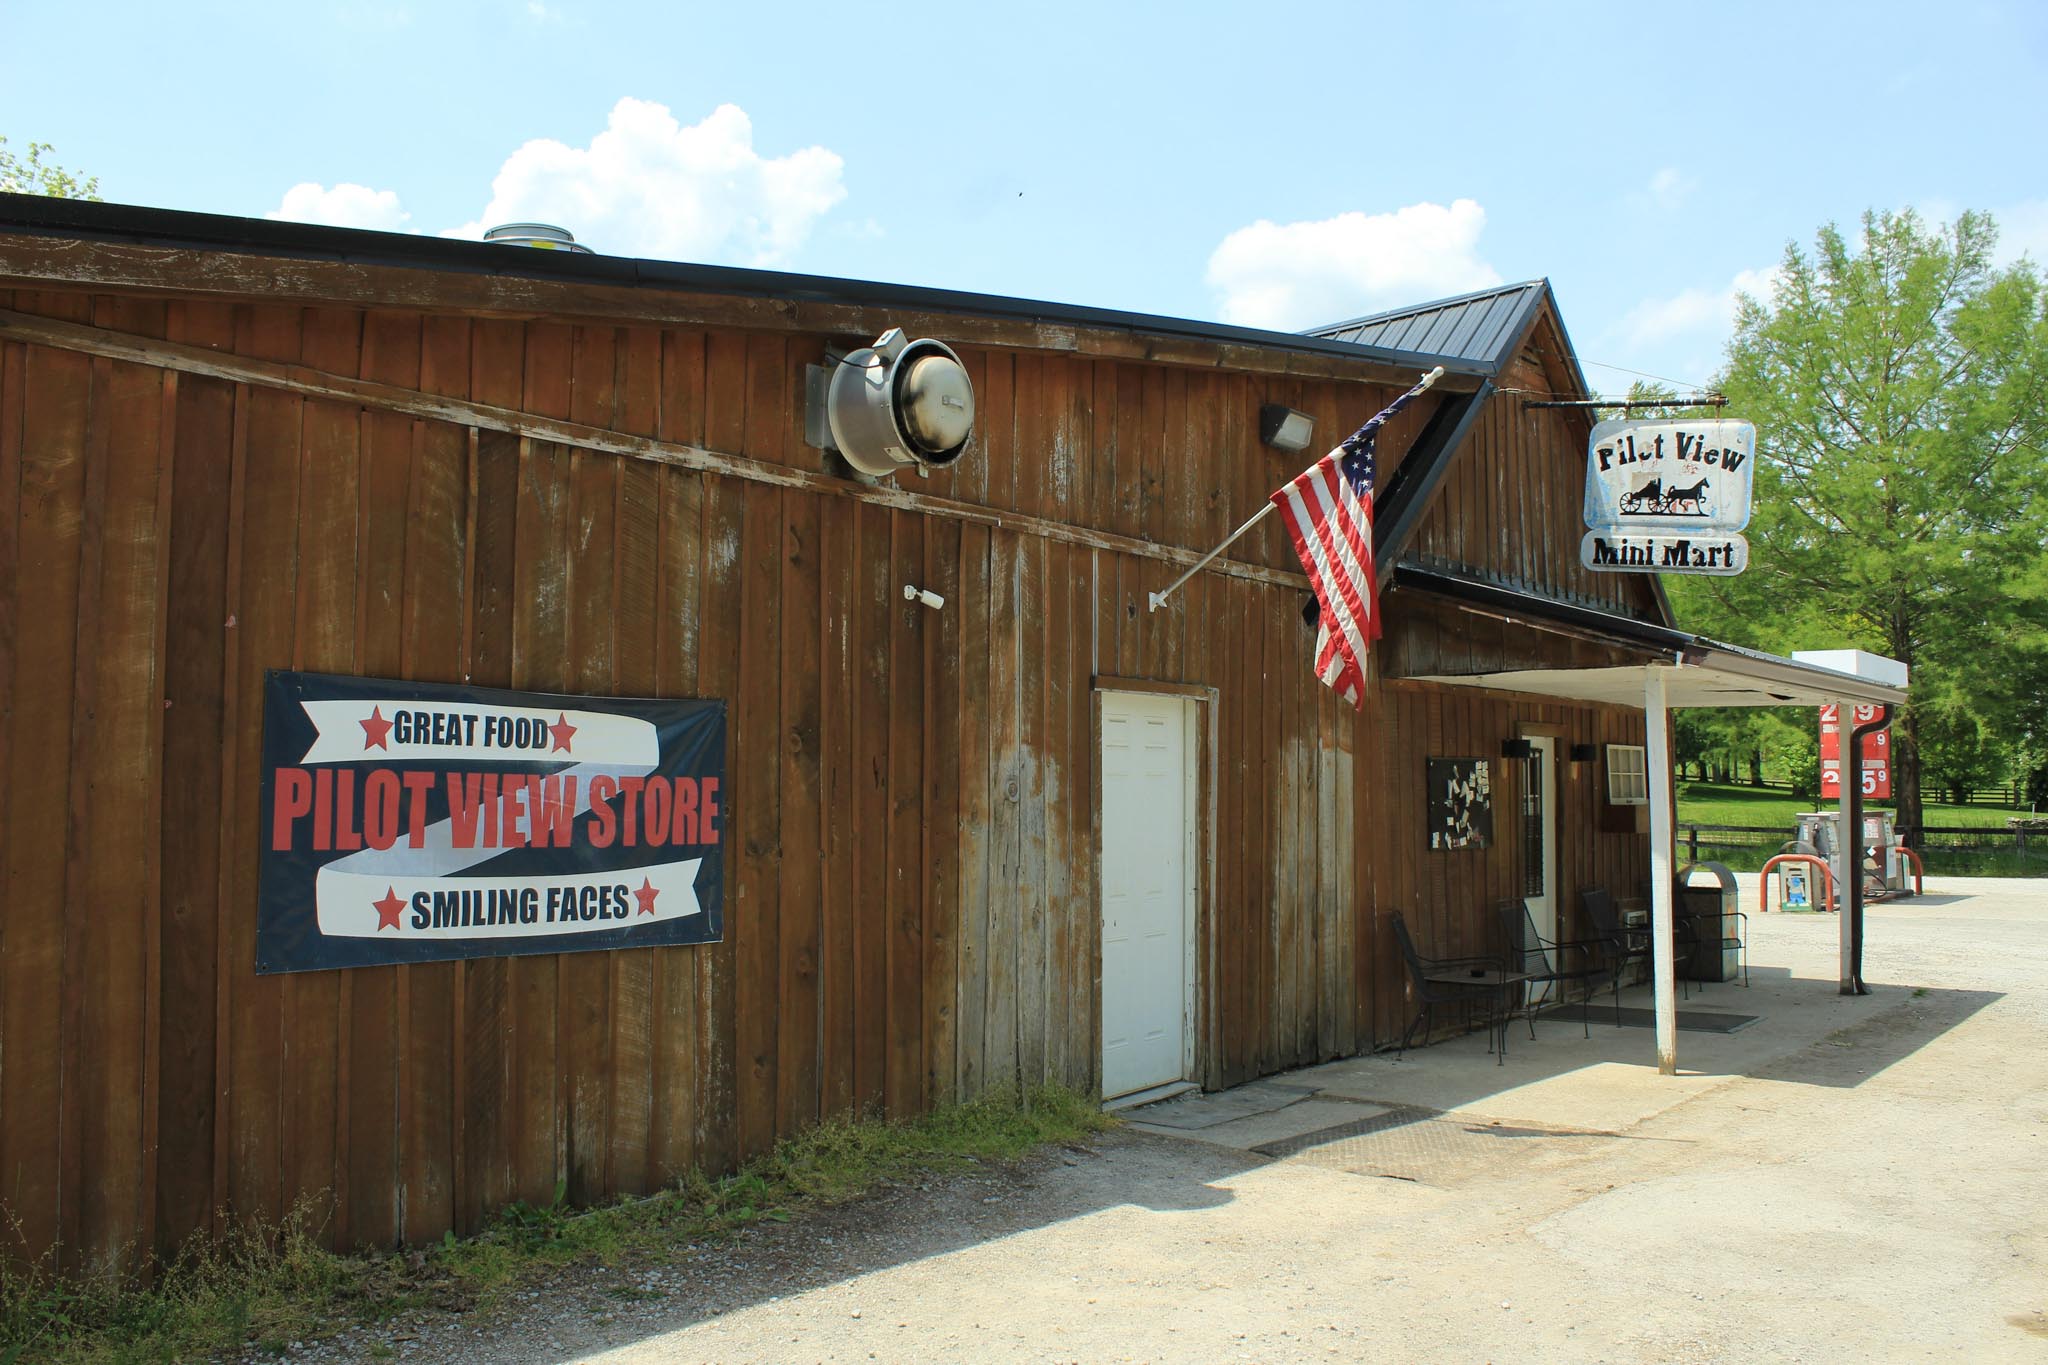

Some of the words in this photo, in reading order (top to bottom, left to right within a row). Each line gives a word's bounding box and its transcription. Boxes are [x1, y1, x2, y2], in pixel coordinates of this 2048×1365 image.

[1676, 432, 1746, 473] View
[1592, 538, 1653, 564] Mini
[1662, 540, 1734, 567] Mart
[394, 710, 478, 746] GREAT
[484, 715, 549, 749] FOOD
[272, 767, 435, 851] PILOT
[447, 772, 577, 849] VIEW
[588, 775, 719, 848] STORE
[411, 886, 538, 930] SMILING
[546, 884, 629, 922] FACES
